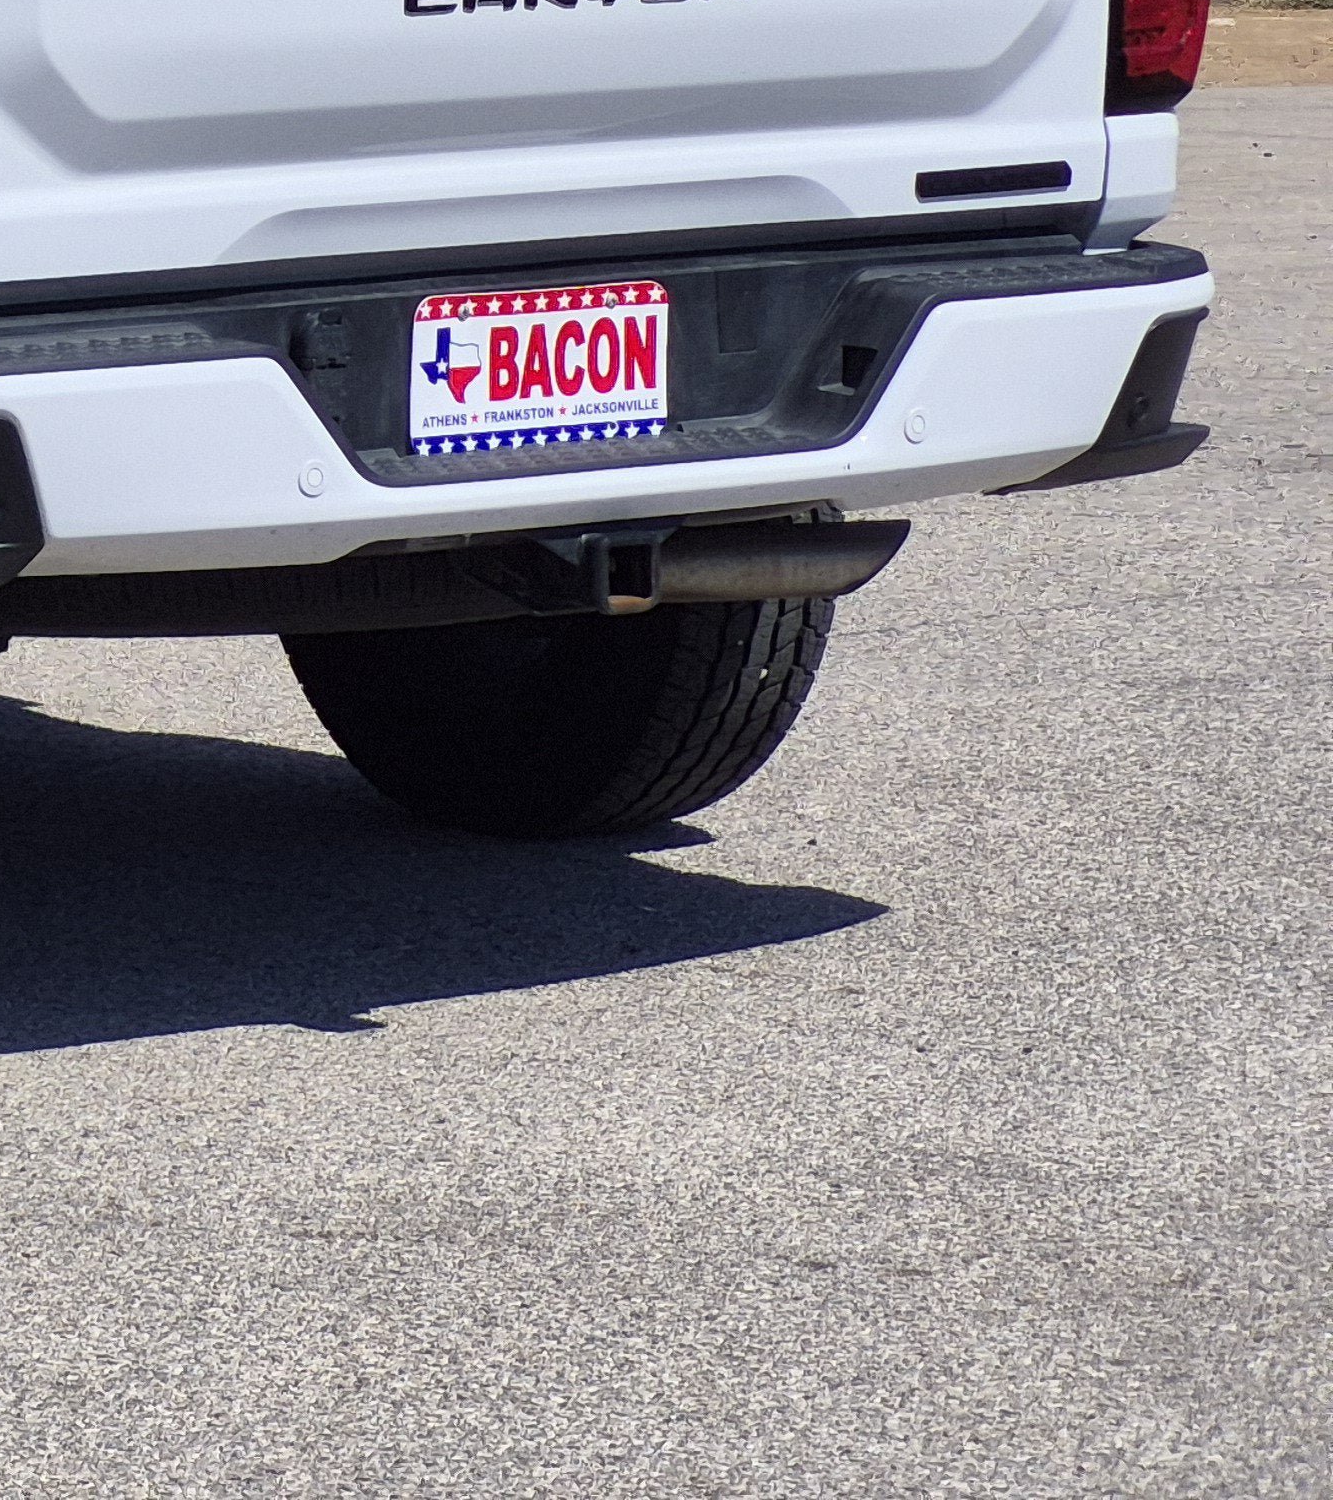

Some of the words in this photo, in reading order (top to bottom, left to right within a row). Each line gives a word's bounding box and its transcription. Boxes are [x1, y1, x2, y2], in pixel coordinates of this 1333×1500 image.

[489, 315, 658, 401] BACON
[422, 413, 467, 428] ATHENS
[484, 406, 554, 423] FRANKSTON
[571, 398, 659, 416] JACKSONVILLE
